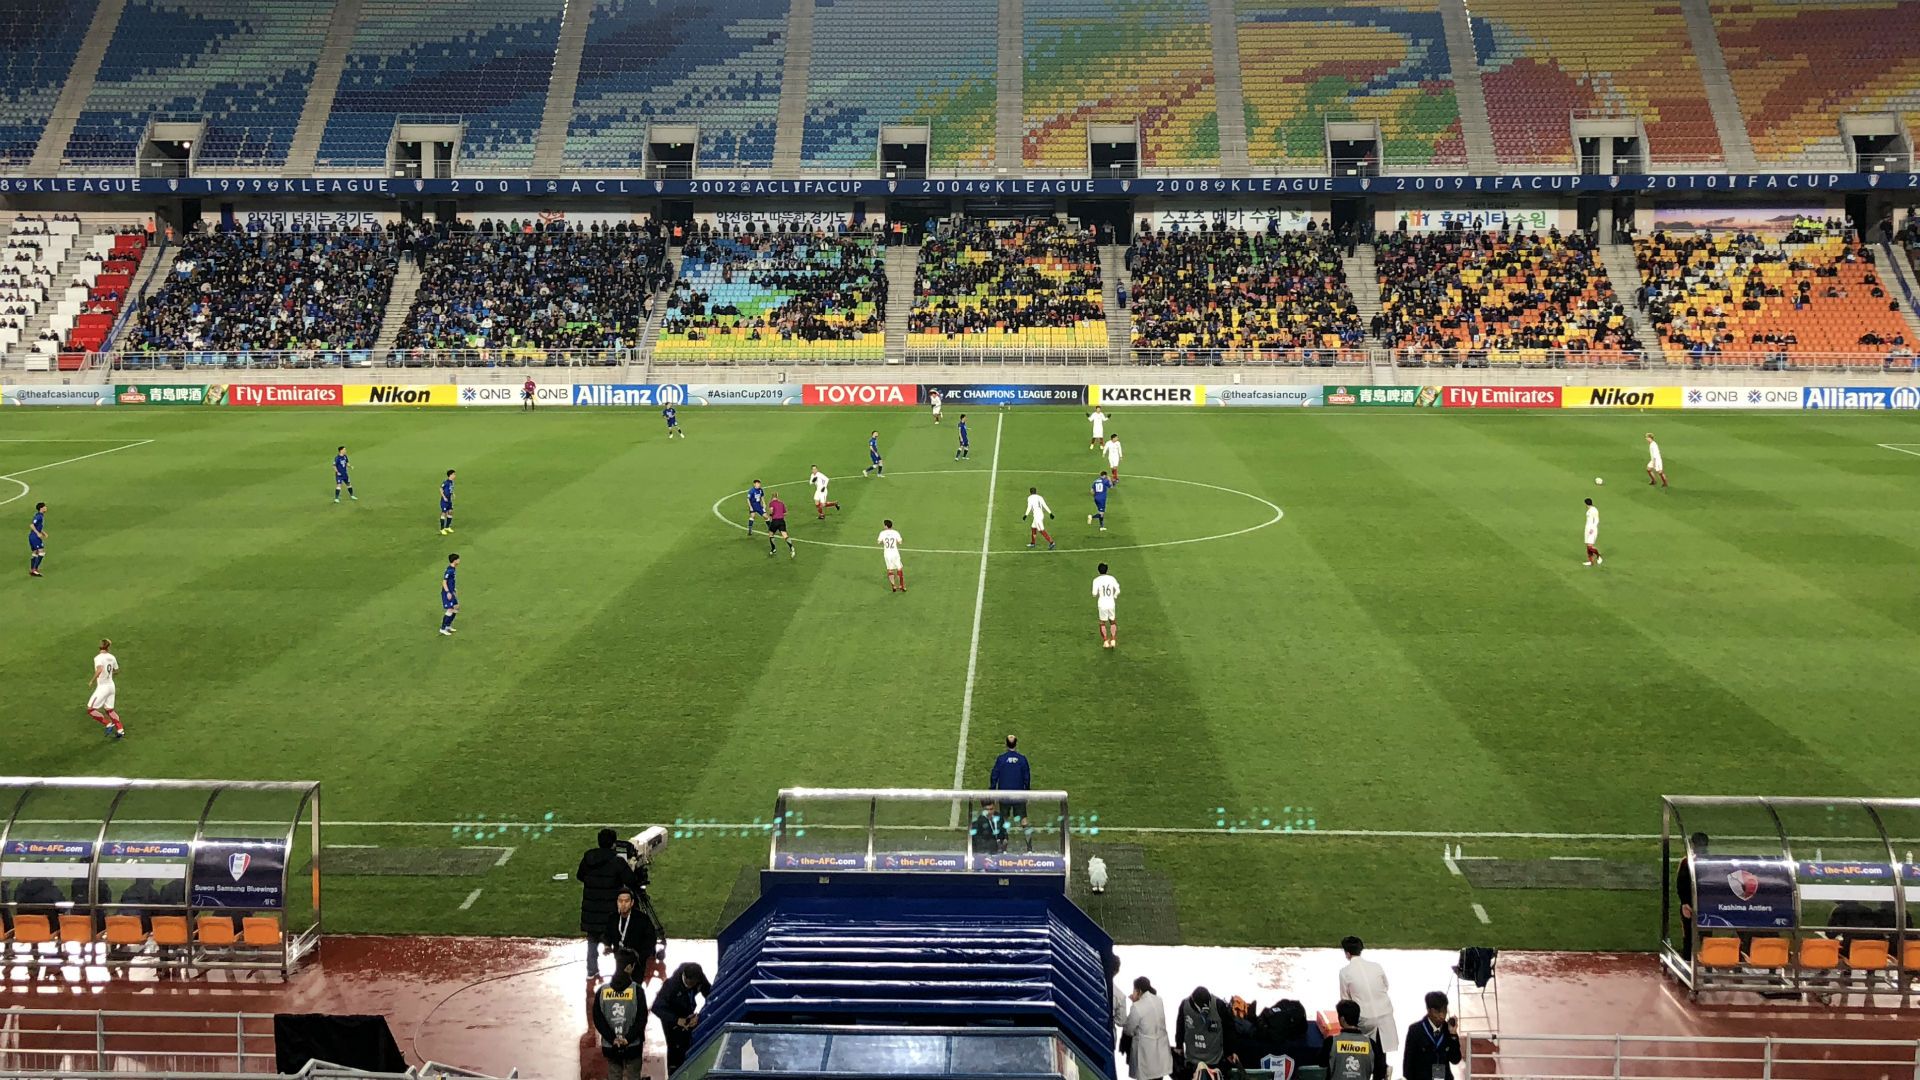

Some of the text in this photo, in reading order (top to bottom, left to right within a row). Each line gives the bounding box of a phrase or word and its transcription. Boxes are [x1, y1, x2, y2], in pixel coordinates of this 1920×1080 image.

[206, 179, 261, 192] 1999
[451, 180, 531, 192] 2001
[689, 180, 736, 193] 2002
[755, 180, 789, 193] ACL
[922, 180, 974, 193] 2004
[1156, 180, 1208, 192] 2008
[1397, 178, 1463, 190] 2009
[1647, 178, 1716, 188] 2010
[335, 210, 377, 227] 경기도
[715, 210, 766, 224] 안전하고
[809, 210, 847, 225] 경기도
[1161, 209, 1206, 225] 스포츠
[1511, 210, 1546, 229] 수원
[16, 388, 100, 400] @theafcasiancup
[236, 386, 336, 404] Fly Emirates
[369, 386, 431, 403] Nikon
[479, 387, 512, 402] QNB
[536, 387, 569, 401] QNB
[575, 384, 652, 405] Allianz
[707, 389, 783, 401] #AsianCup2019
[814, 385, 905, 403] TOYOTA
[945, 389, 1078, 400] AFC CHAMPIONS LEAGUE 2018
[1102, 386, 1192, 402] KÄRCHER
[1221, 390, 1307, 402] @theafcasiancup
[1450, 387, 1555, 407] Fly Emirates
[1590, 388, 1654, 406] Nikon
[1705, 390, 1739, 403] QNB
[1764, 390, 1798, 403] QNB
[1806, 386, 1887, 409] Allianz
[1095, 482, 1104, 493] 10
[884, 537, 895, 549] 32
[1102, 584, 1112, 597] 16
[29, 843, 84, 853] the-AFC.com
[126, 845, 180, 855] the-AFC.com
[800, 856, 856, 866] the-AFC.com
[900, 857, 956, 867] the-AFC.com
[998, 858, 1055, 868] the-AFC.com
[1823, 866, 1883, 875] the-AFC.com
[1718, 903, 1773, 912] Kashima Antlers
[605, 988, 630, 999] Nikon
[1340, 1043, 1367, 1053] Nikon
